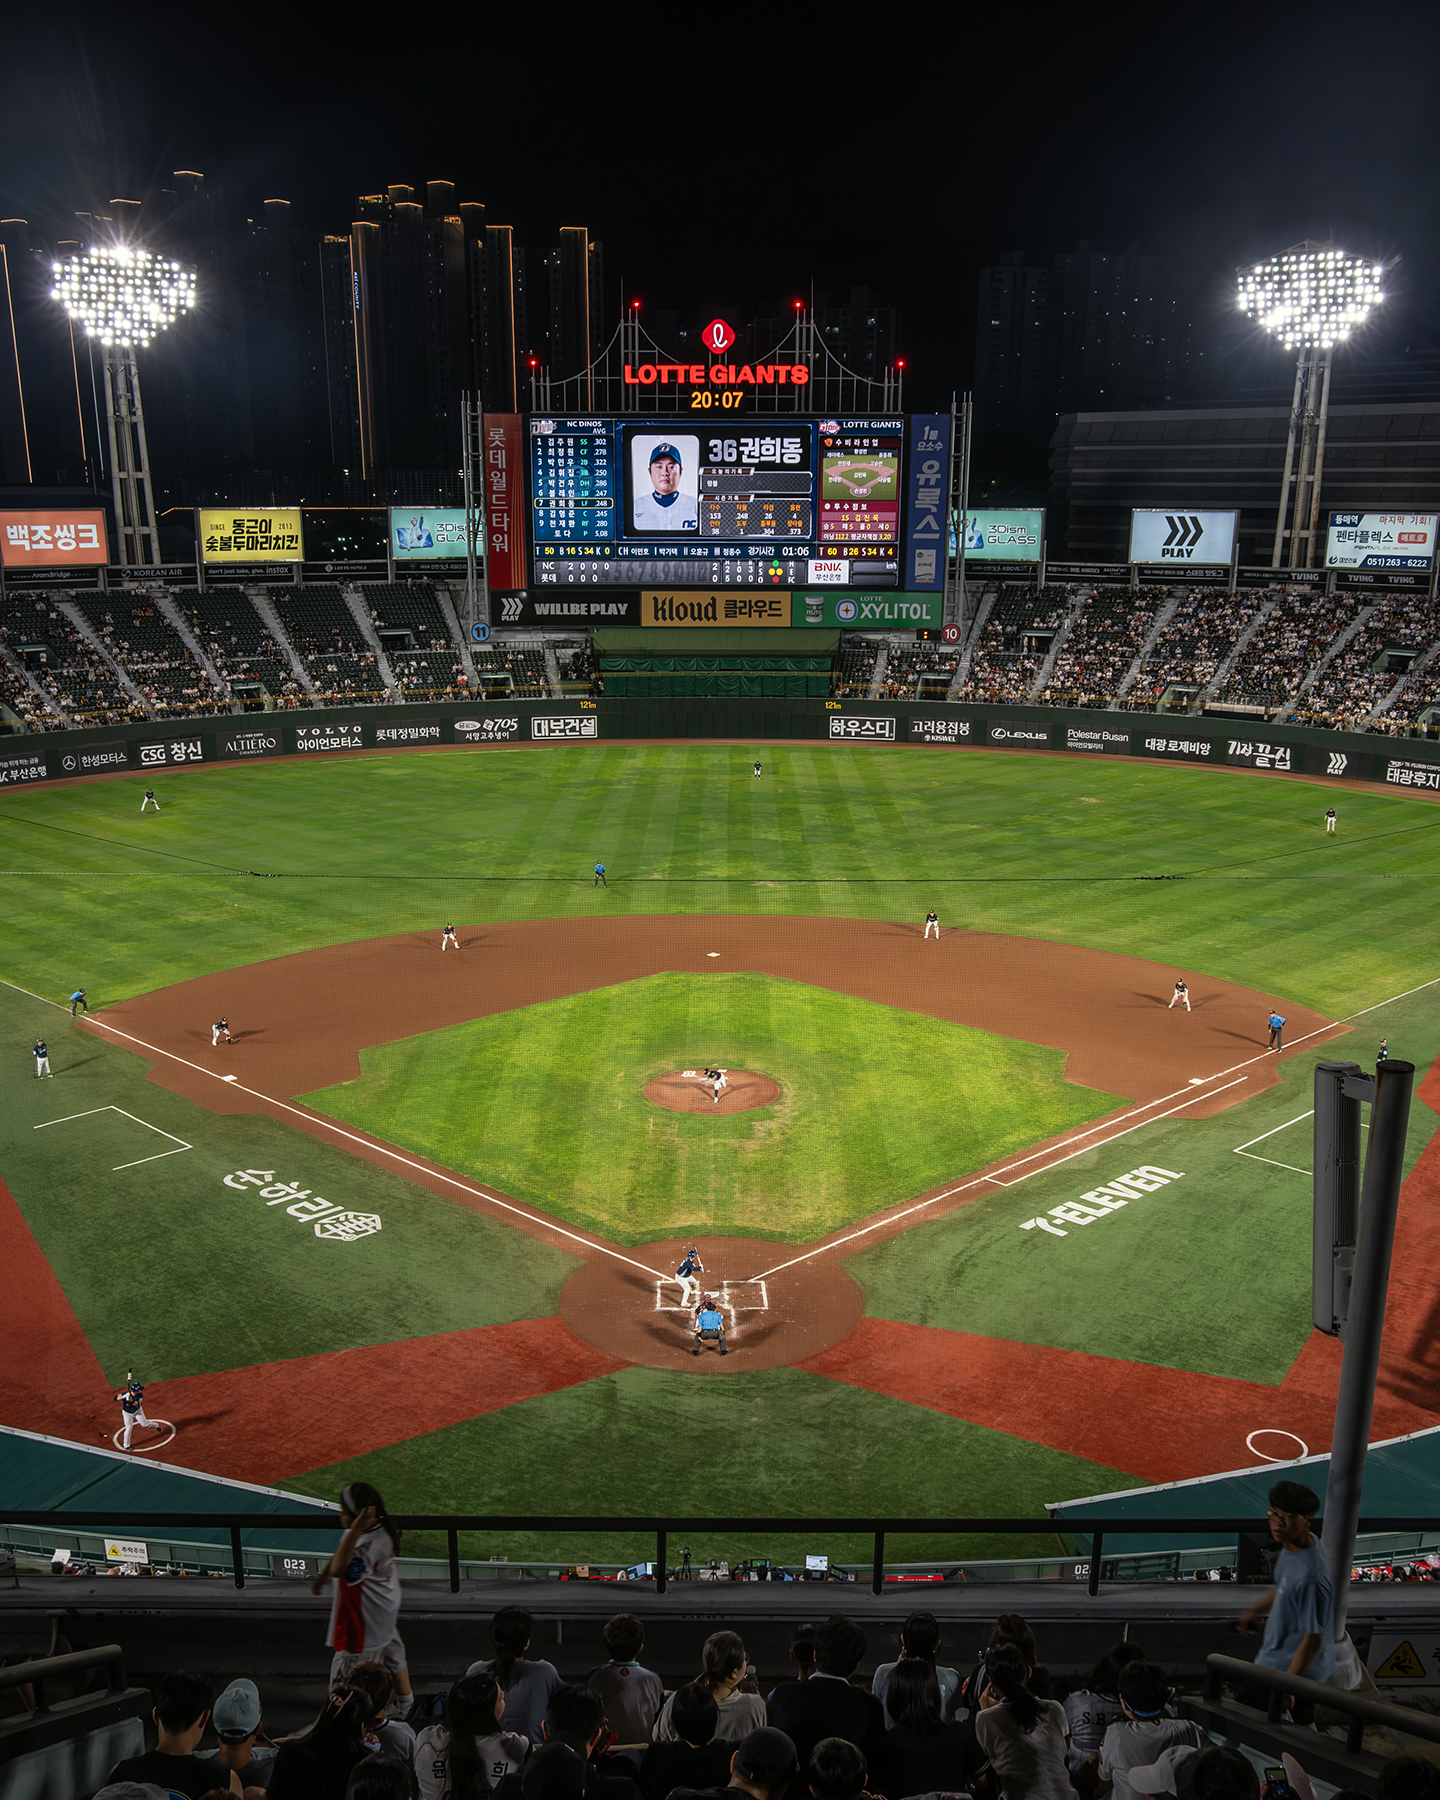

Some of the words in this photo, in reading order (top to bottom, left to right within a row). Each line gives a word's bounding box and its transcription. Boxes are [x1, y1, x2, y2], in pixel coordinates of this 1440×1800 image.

[624, 364, 705, 384] LOTTE
[709, 364, 809, 384] GIANTS
[691, 392, 743, 408] 20:07
[709, 440, 737, 462] 36
[739, 437, 802, 464] 권희동
[917, 442, 943, 451] 요소수
[489, 428, 509, 552] 롯데월드타워
[232, 519, 272, 534] 동근이
[1380, 516, 1405, 525] 마지막
[1410, 516, 1431, 525] 기회!
[988, 525, 1026, 534] 3Dism
[6, 524, 99, 551] 백조씽크
[205, 535, 298, 551] 숯불두마리치킨
[988, 536, 1036, 544] GLASS
[1336, 530, 1394, 543] 펜타플렉스
[748, 547, 775, 555] 경기시간
[782, 547, 809, 556] 01:06
[1162, 548, 1194, 557] PLAY
[814, 563, 842, 571] BNK
[1367, 558, 1384, 566] 051)
[541, 574, 556, 582] 롯데
[1348, 574, 1374, 582] TVING
[535, 604, 588, 615] WILLBE
[590, 604, 628, 615] PLAY
[652, 596, 718, 622] Kloud
[724, 599, 782, 618] 클라우드
[860, 604, 931, 619] XYLITOL
[475, 627, 486, 637] 11
[945, 628, 957, 639] 10
[296, 726, 361, 736] VOLVO
[494, 719, 518, 731] 705
[534, 718, 595, 736] 대보건설
[912, 721, 970, 736] 고려용접봉
[376, 726, 440, 741] 롯데정밀화학
[465, 732, 509, 740] 서양고추냉이
[1007, 731, 1048, 740] LEXUS
[1067, 729, 1101, 739] Polestar
[1103, 731, 1128, 742] Busan
[297, 737, 362, 750] 아이언모터스
[141, 749, 166, 761] CSG
[171, 741, 202, 761] 창신
[81, 752, 127, 768] 한성모터스
[10, 766, 47, 780] 부산은행
[1387, 768, 1439, 789] 태광후지
[222, 1169, 344, 1223] 순하리
[284, 1559, 306, 1570] 023
[1075, 1564, 1091, 1574] 02
